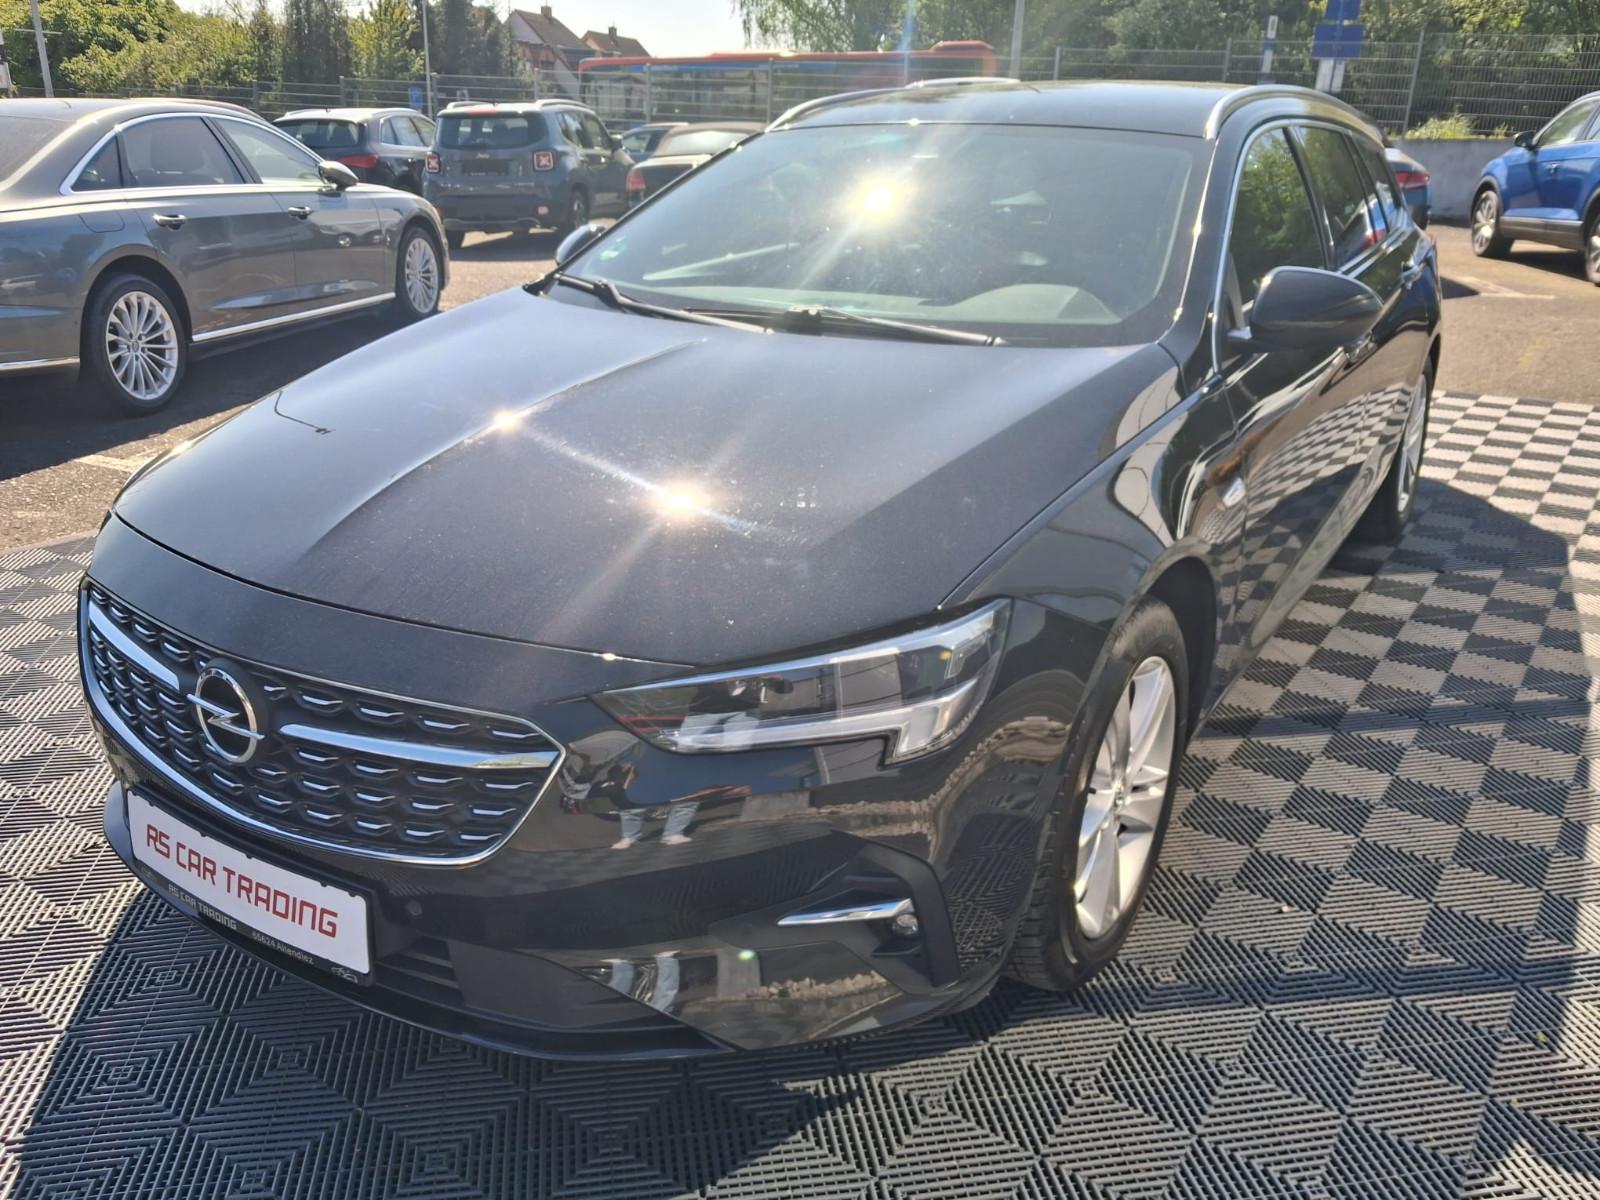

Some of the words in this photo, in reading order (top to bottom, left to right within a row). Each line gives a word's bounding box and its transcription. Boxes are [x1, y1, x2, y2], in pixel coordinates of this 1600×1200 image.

[147, 824, 170, 859] RS
[176, 841, 217, 886] CAR
[222, 866, 338, 938] TRADING
[168, 884, 179, 897] RS
[181, 893, 197, 908] CAR
[199, 902, 237, 930] TRADING
